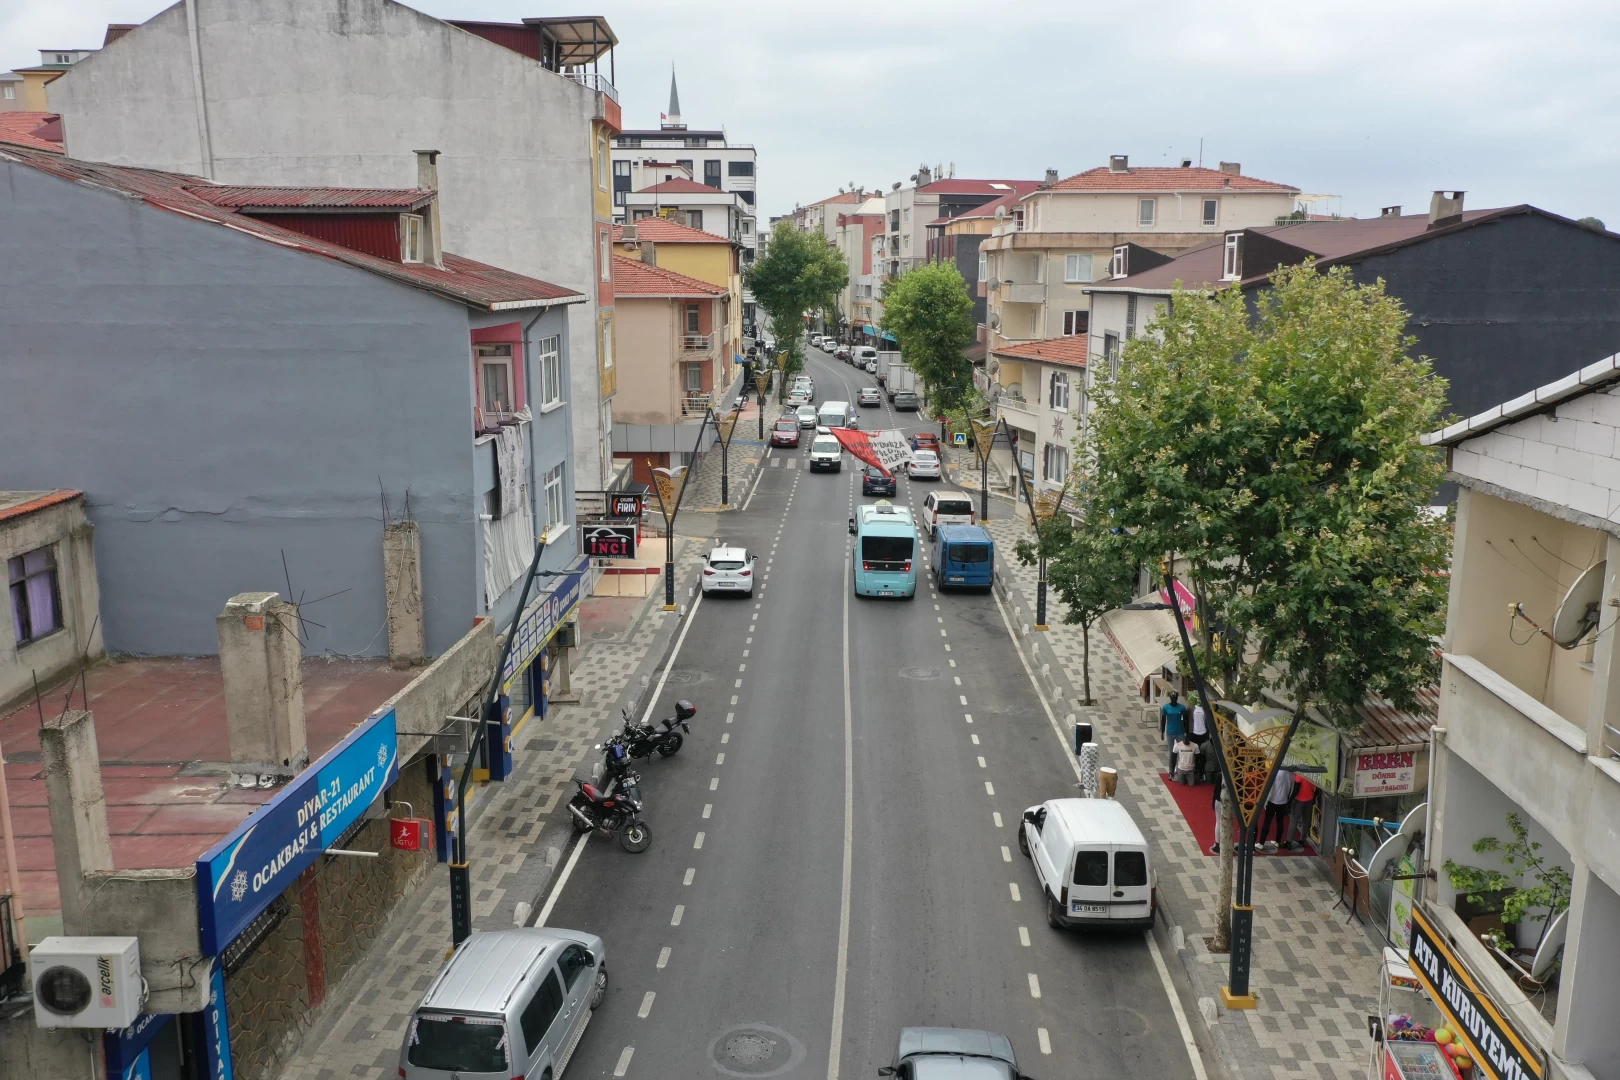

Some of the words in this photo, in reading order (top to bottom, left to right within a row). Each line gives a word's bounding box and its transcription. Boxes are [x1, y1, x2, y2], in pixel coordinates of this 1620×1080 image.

[617, 503, 636, 513] FIRIN
[1357, 751, 1415, 771] EREN
[1372, 772, 1396, 780] DÖNER
[297, 776, 341, 828] DİYAR-21
[252, 828, 309, 893] OCAKBAŞI
[310, 821, 318, 840] &
[319, 766, 376, 832] RESTAURANT
[97, 956, 113, 996] arçelik
[1414, 933, 1439, 985] ATA
[1441, 967, 1529, 1080] KURUYEMİ
